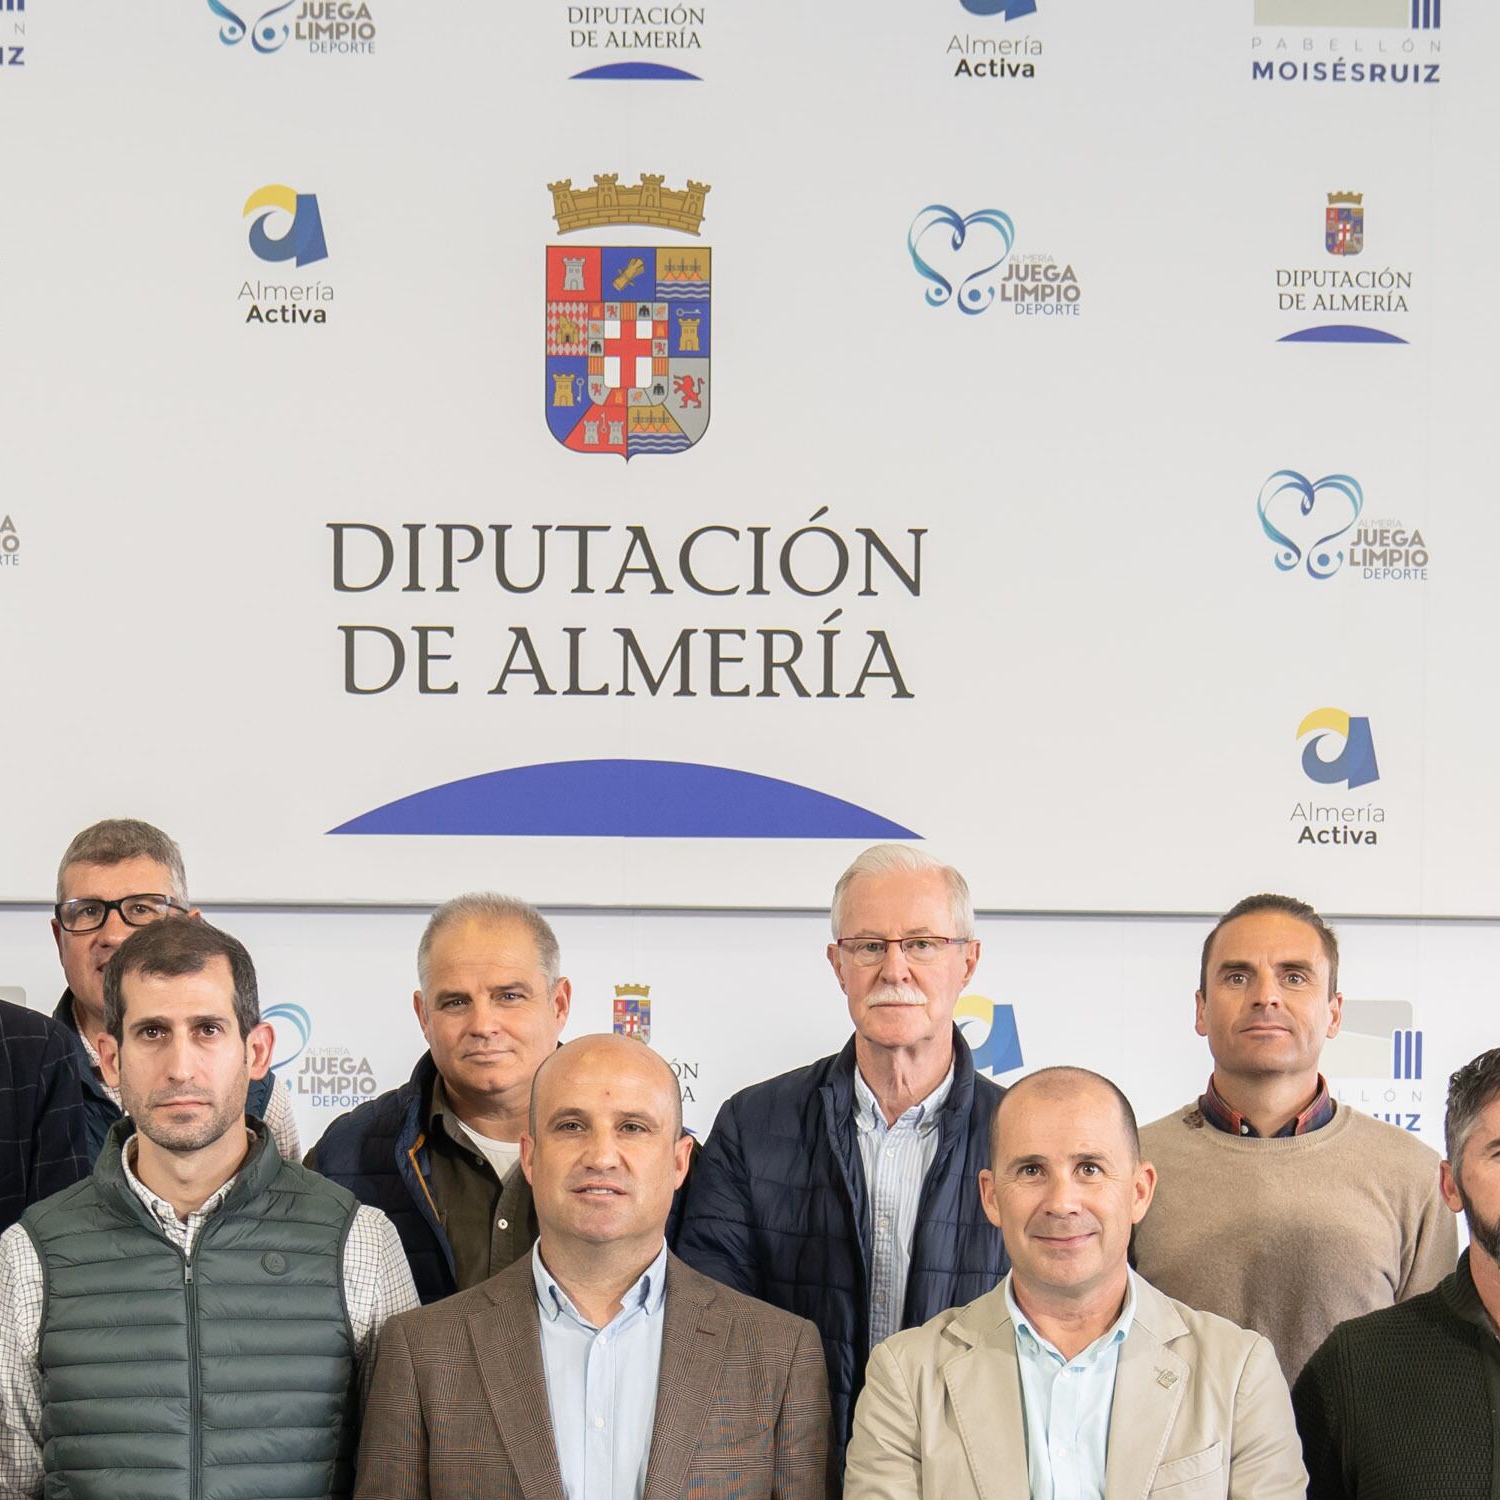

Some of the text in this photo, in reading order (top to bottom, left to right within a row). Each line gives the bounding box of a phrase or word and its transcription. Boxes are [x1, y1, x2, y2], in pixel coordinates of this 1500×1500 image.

[293, 1, 372, 21] JUEGA
[568, 4, 704, 24] DIPUTACIÓN
[295, 21, 375, 41] LIMPIO
[571, 27, 701, 48] DE ALMERÍA
[310, 40, 374, 53] DEPORTE
[947, 35, 1042, 55] Almería
[1252, 37, 1441, 53] PABELLÓN
[955, 58, 1034, 78] Activa
[1253, 58, 1440, 83] MOISÉSRUIZ
[998, 264, 1077, 284] JUEGA
[1276, 268, 1412, 288] DIPUTACIÓN
[238, 281, 333, 305] Almería
[1001, 282, 1080, 304] LIMPIO
[1279, 291, 1408, 312] DE ALMERÍA
[246, 304, 326, 323] Activa
[1011, 301, 1079, 315] DEPORTE
[1348, 529, 1425, 549] JUEGA
[326, 506, 928, 597] DIPUTACIÓN
[1349, 547, 1428, 569] LIMPIO
[1364, 566, 1428, 580] DEPORTE
[337, 608, 915, 698] DE ALMERÍA
[1290, 802, 1384, 822] Almería
[1298, 825, 1377, 845] Activa
[298, 1057, 373, 1075] JUEGA
[297, 1076, 377, 1095] LIMPIO
